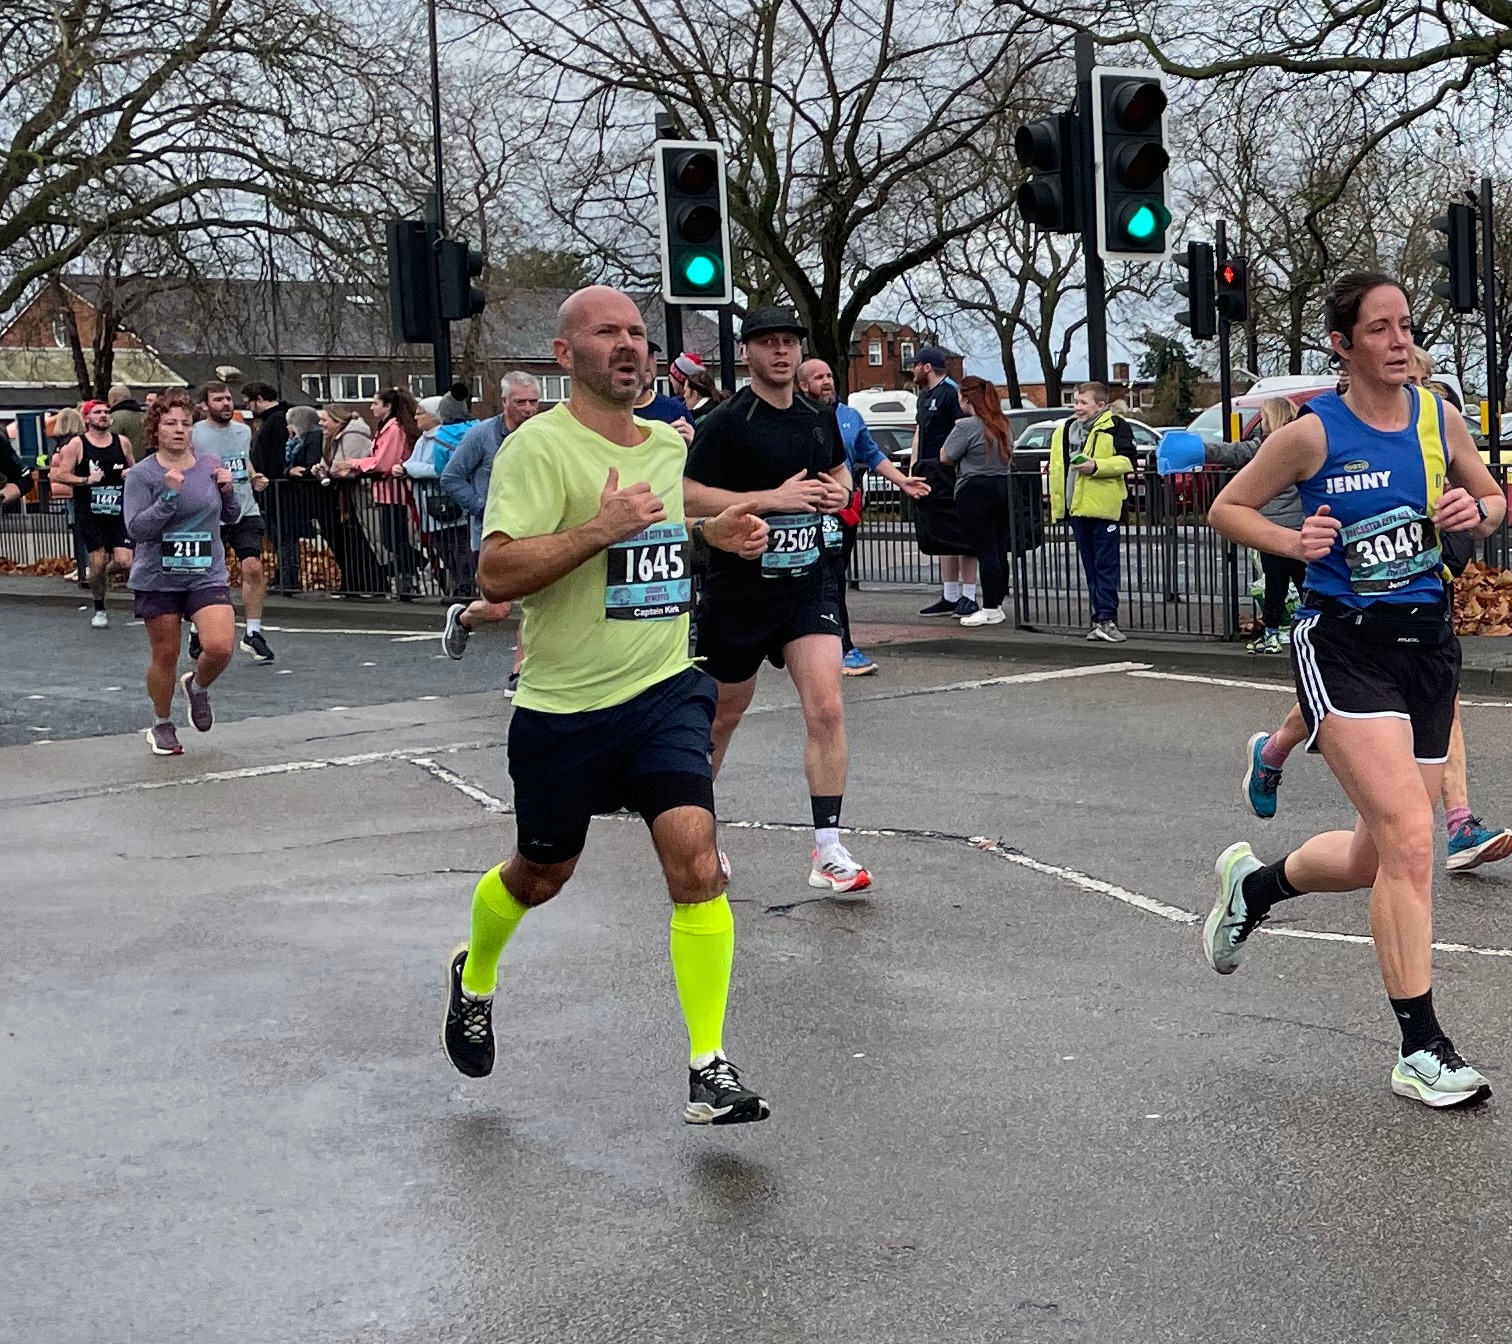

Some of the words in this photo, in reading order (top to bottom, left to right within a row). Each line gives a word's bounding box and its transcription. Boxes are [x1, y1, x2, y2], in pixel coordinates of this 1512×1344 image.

[1325, 471, 1391, 494] JENNY
[96, 494, 118, 505] 1447
[173, 541, 200, 557] 211
[773, 526, 817, 552] 2502
[1356, 522, 1423, 568] 3049
[625, 544, 684, 583] 1645
[634, 607, 663, 617] Captain
[664, 605, 680, 614] Kirk
